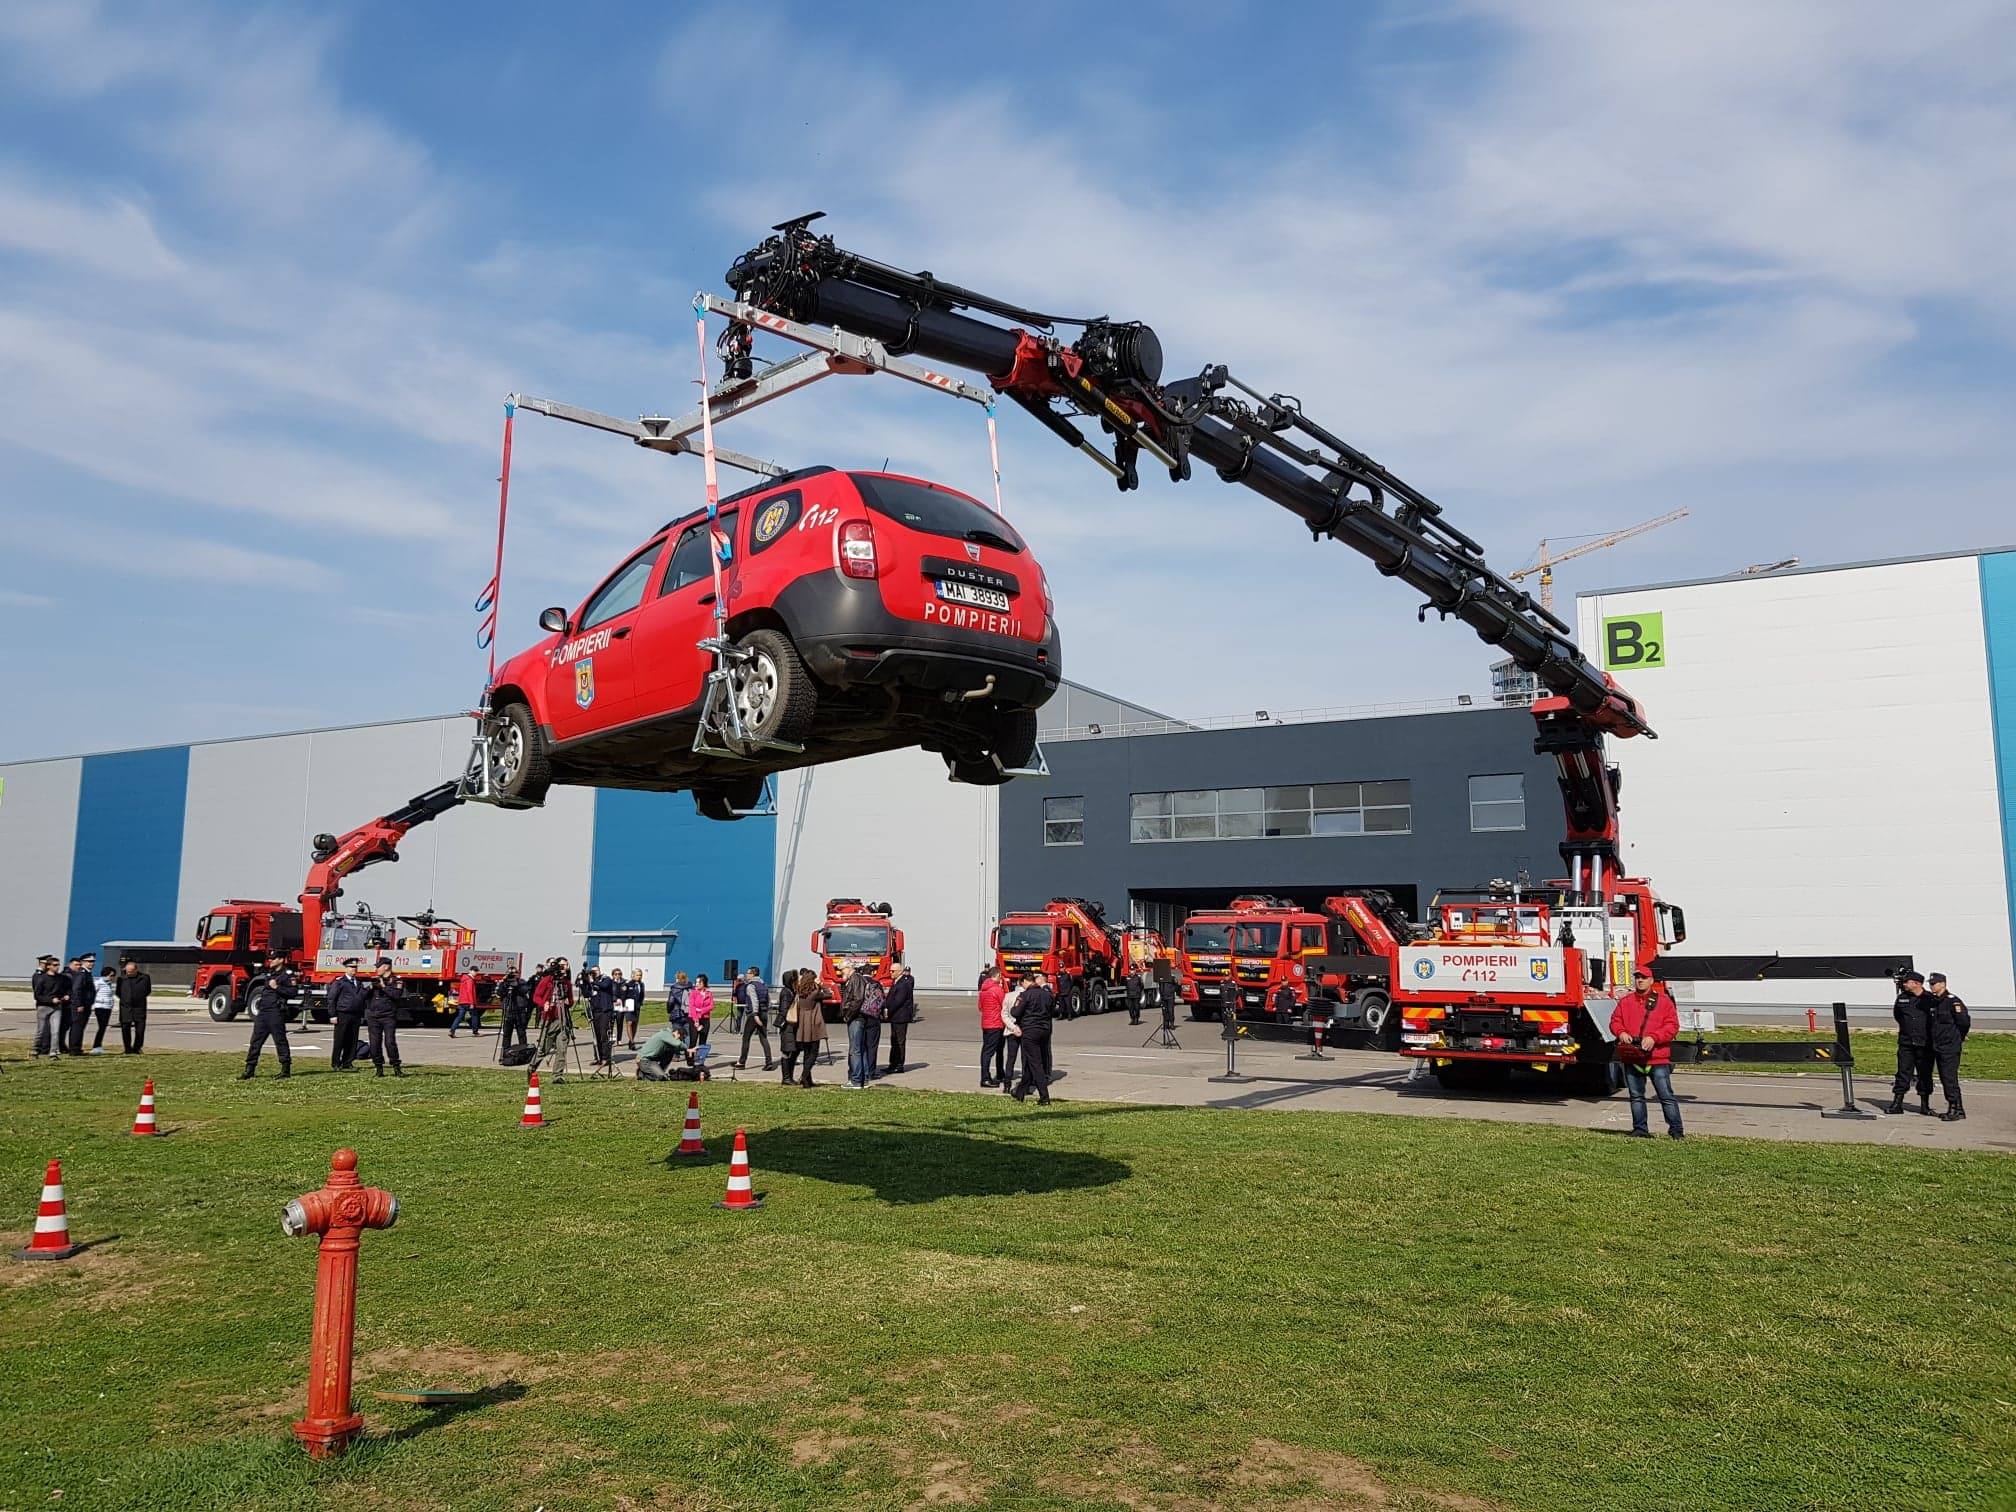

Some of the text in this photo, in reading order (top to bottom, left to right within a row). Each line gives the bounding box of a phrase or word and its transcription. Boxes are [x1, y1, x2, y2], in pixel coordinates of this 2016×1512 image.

[809, 508, 839, 528] 112
[947, 567, 1004, 587] DUSTER
[944, 581, 1007, 608] MAI 38939
[924, 601, 1021, 637] POMPIERII
[551, 627, 613, 669] POMPIERII
[1606, 620, 1661, 665] B2
[1442, 955, 1517, 967] POMPIERII
[1472, 970, 1497, 982] 112
